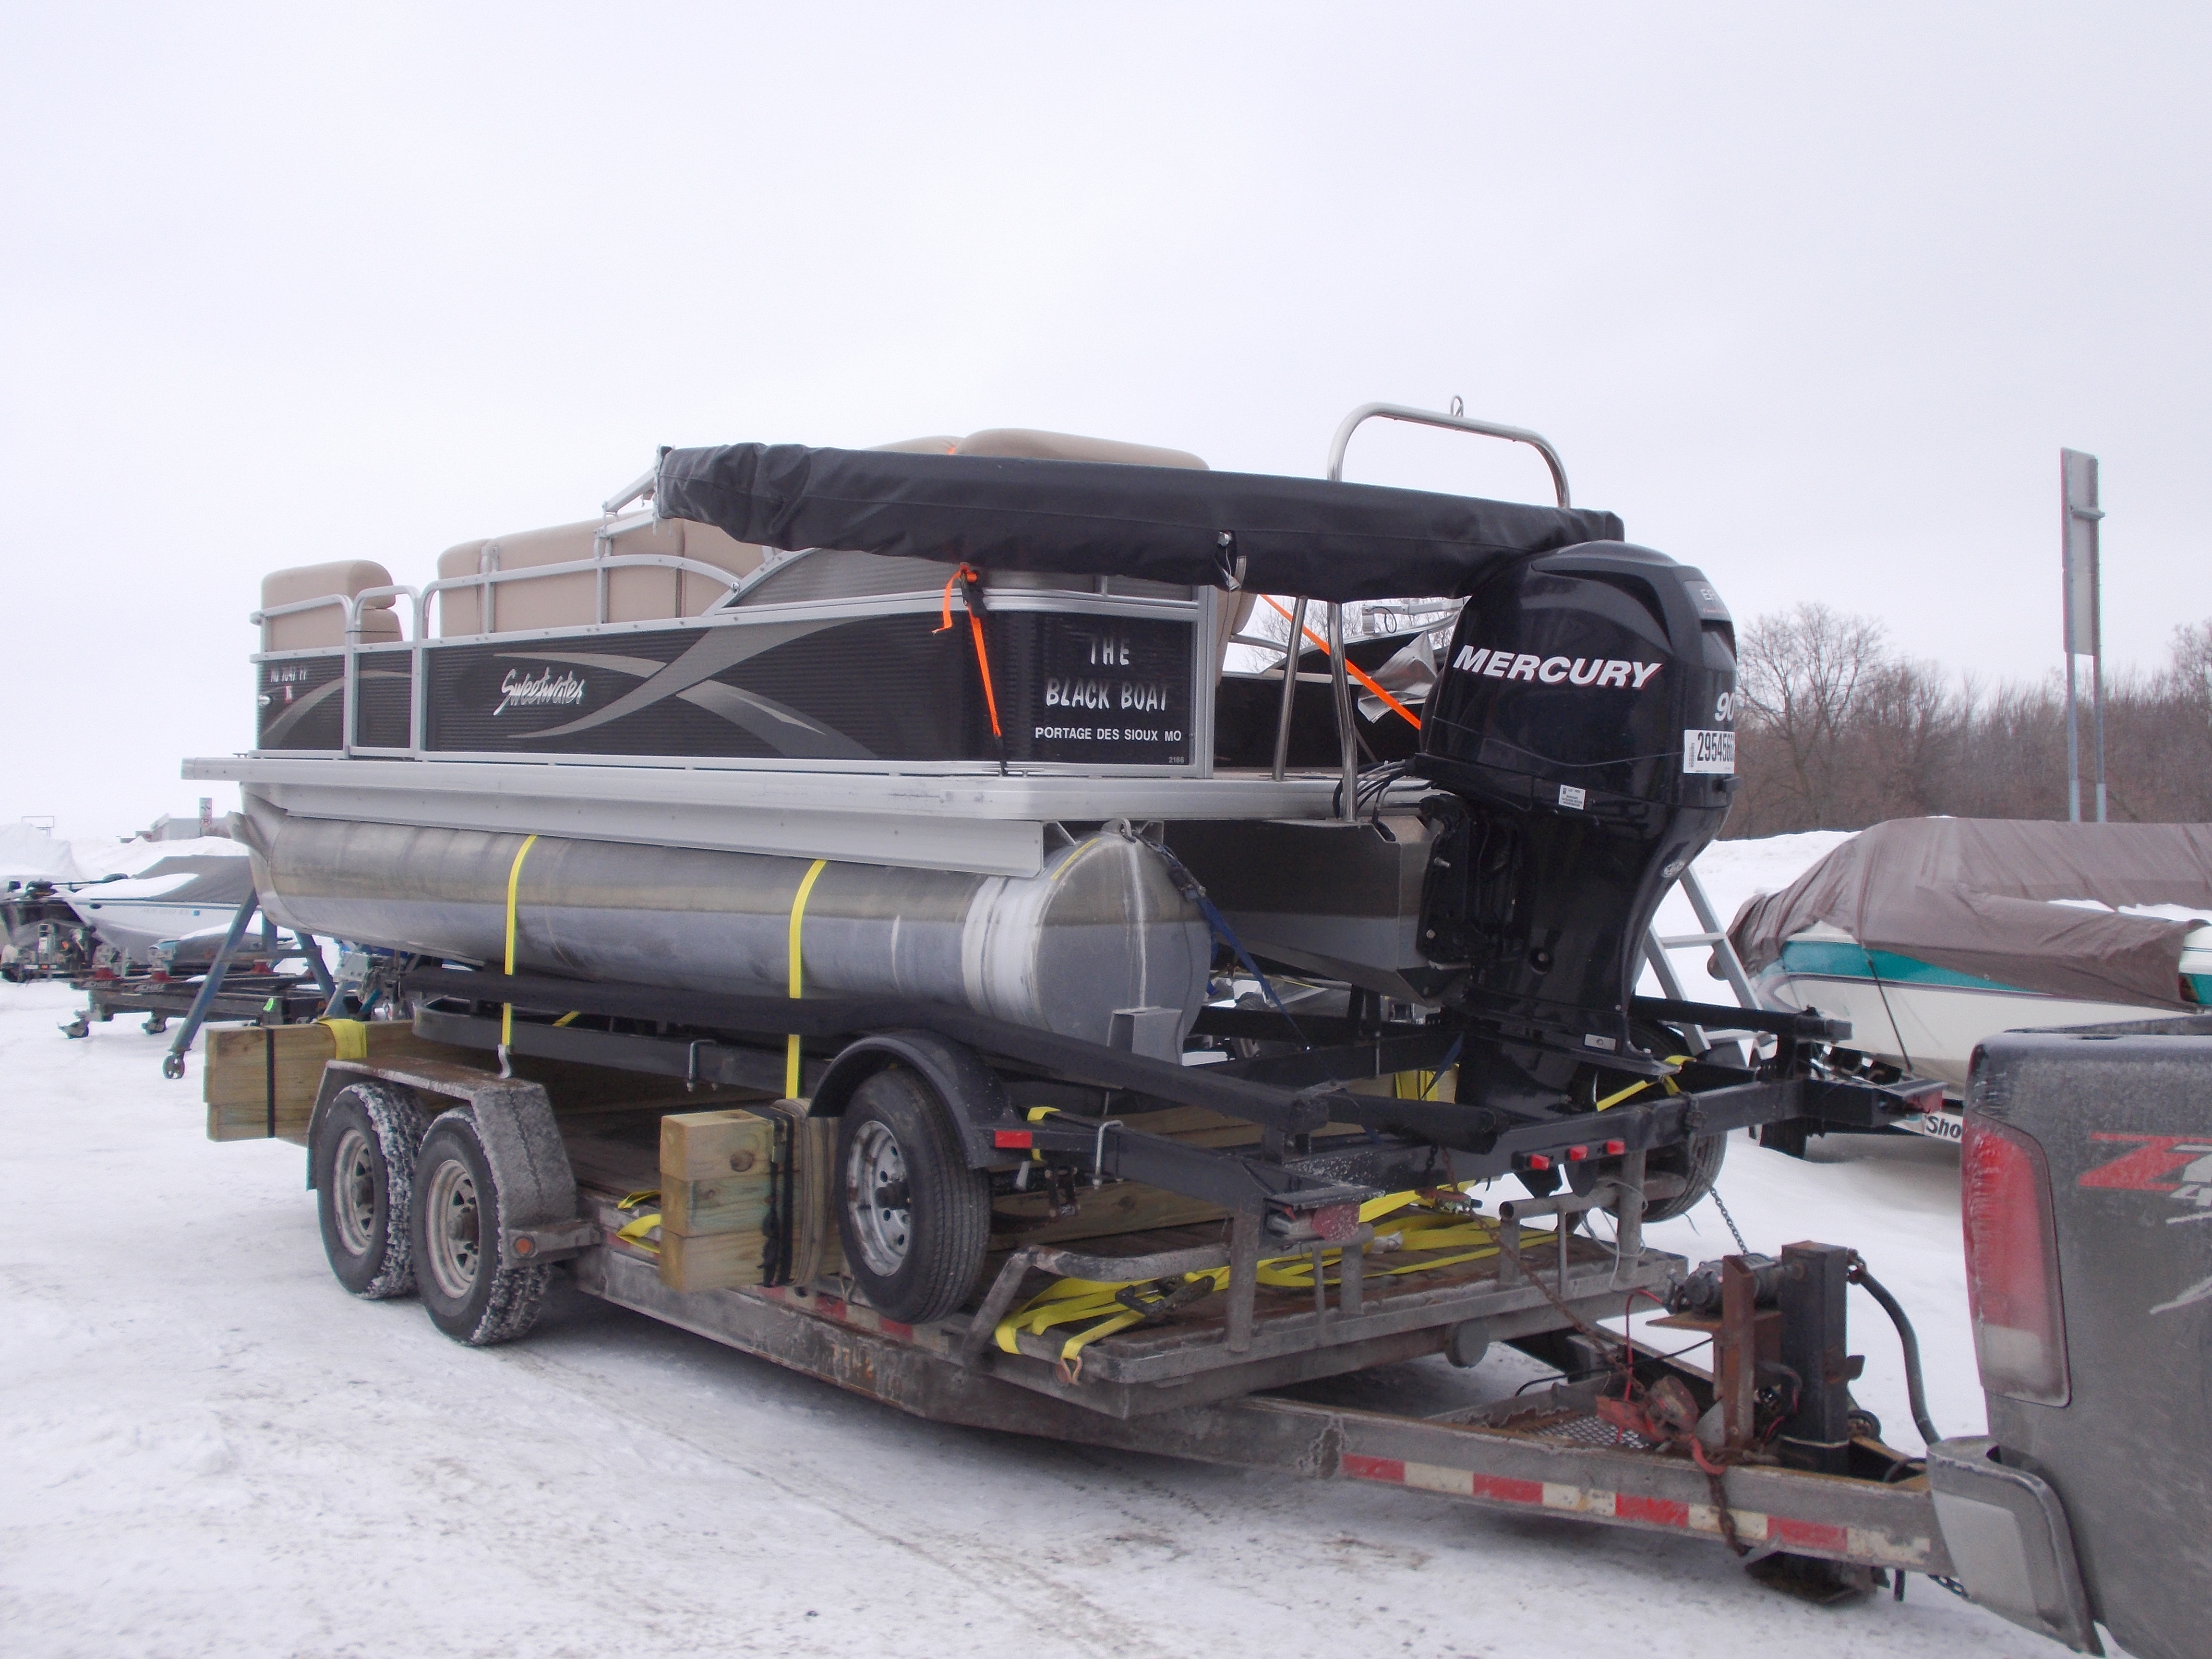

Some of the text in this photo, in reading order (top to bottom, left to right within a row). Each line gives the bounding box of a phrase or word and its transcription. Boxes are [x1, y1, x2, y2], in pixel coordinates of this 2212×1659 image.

[1090, 637, 1130, 666] THE
[1453, 645, 1664, 690] MERCURY
[493, 667, 586, 716] Sweetwater
[1046, 677, 1169, 712] BLACK BOAT
[1714, 691, 1735, 721] 90
[1035, 726, 1182, 742] PORTAGE DES SIOUX MO
